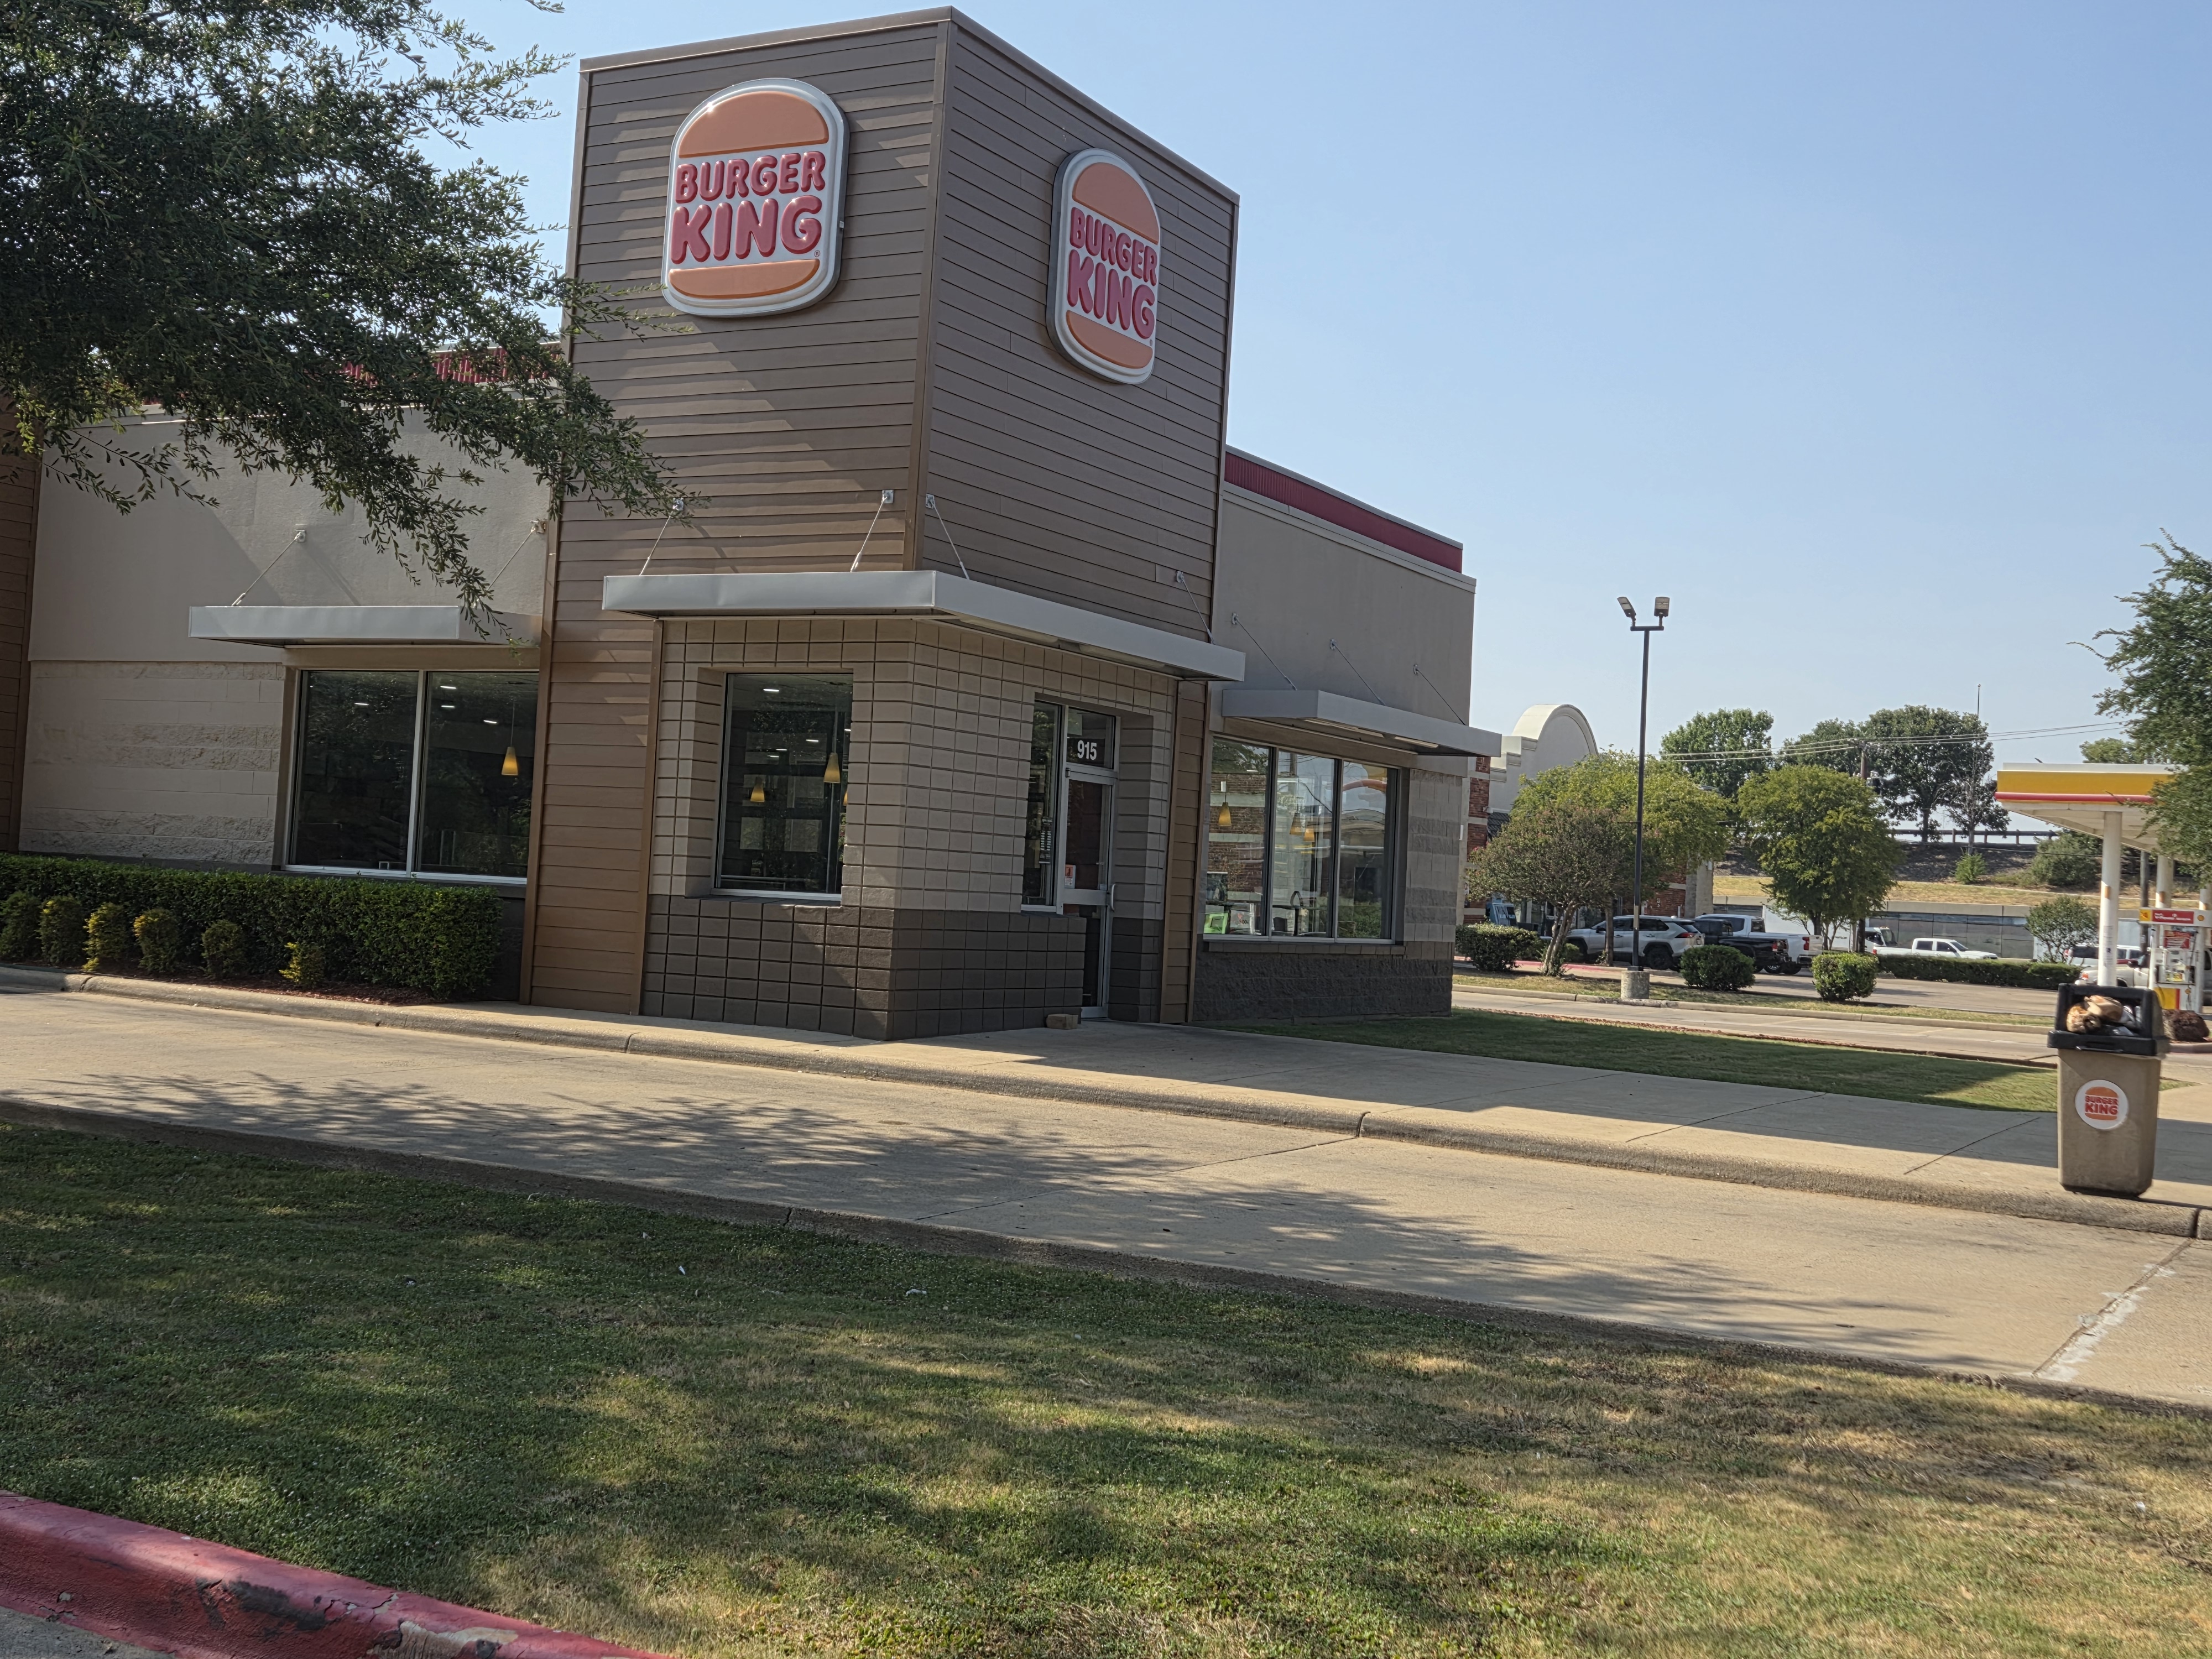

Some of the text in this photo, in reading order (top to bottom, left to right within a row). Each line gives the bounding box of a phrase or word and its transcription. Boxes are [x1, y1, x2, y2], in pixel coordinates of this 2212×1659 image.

[675, 151, 826, 204] BURGER
[671, 195, 822, 264] KING
[1070, 207, 1157, 286] BURGER
[1067, 249, 1155, 339] KING
[1077, 740, 1097, 760] 915
[2085, 1095, 2118, 1105] BURGER
[2085, 1103, 2118, 1115] KING
